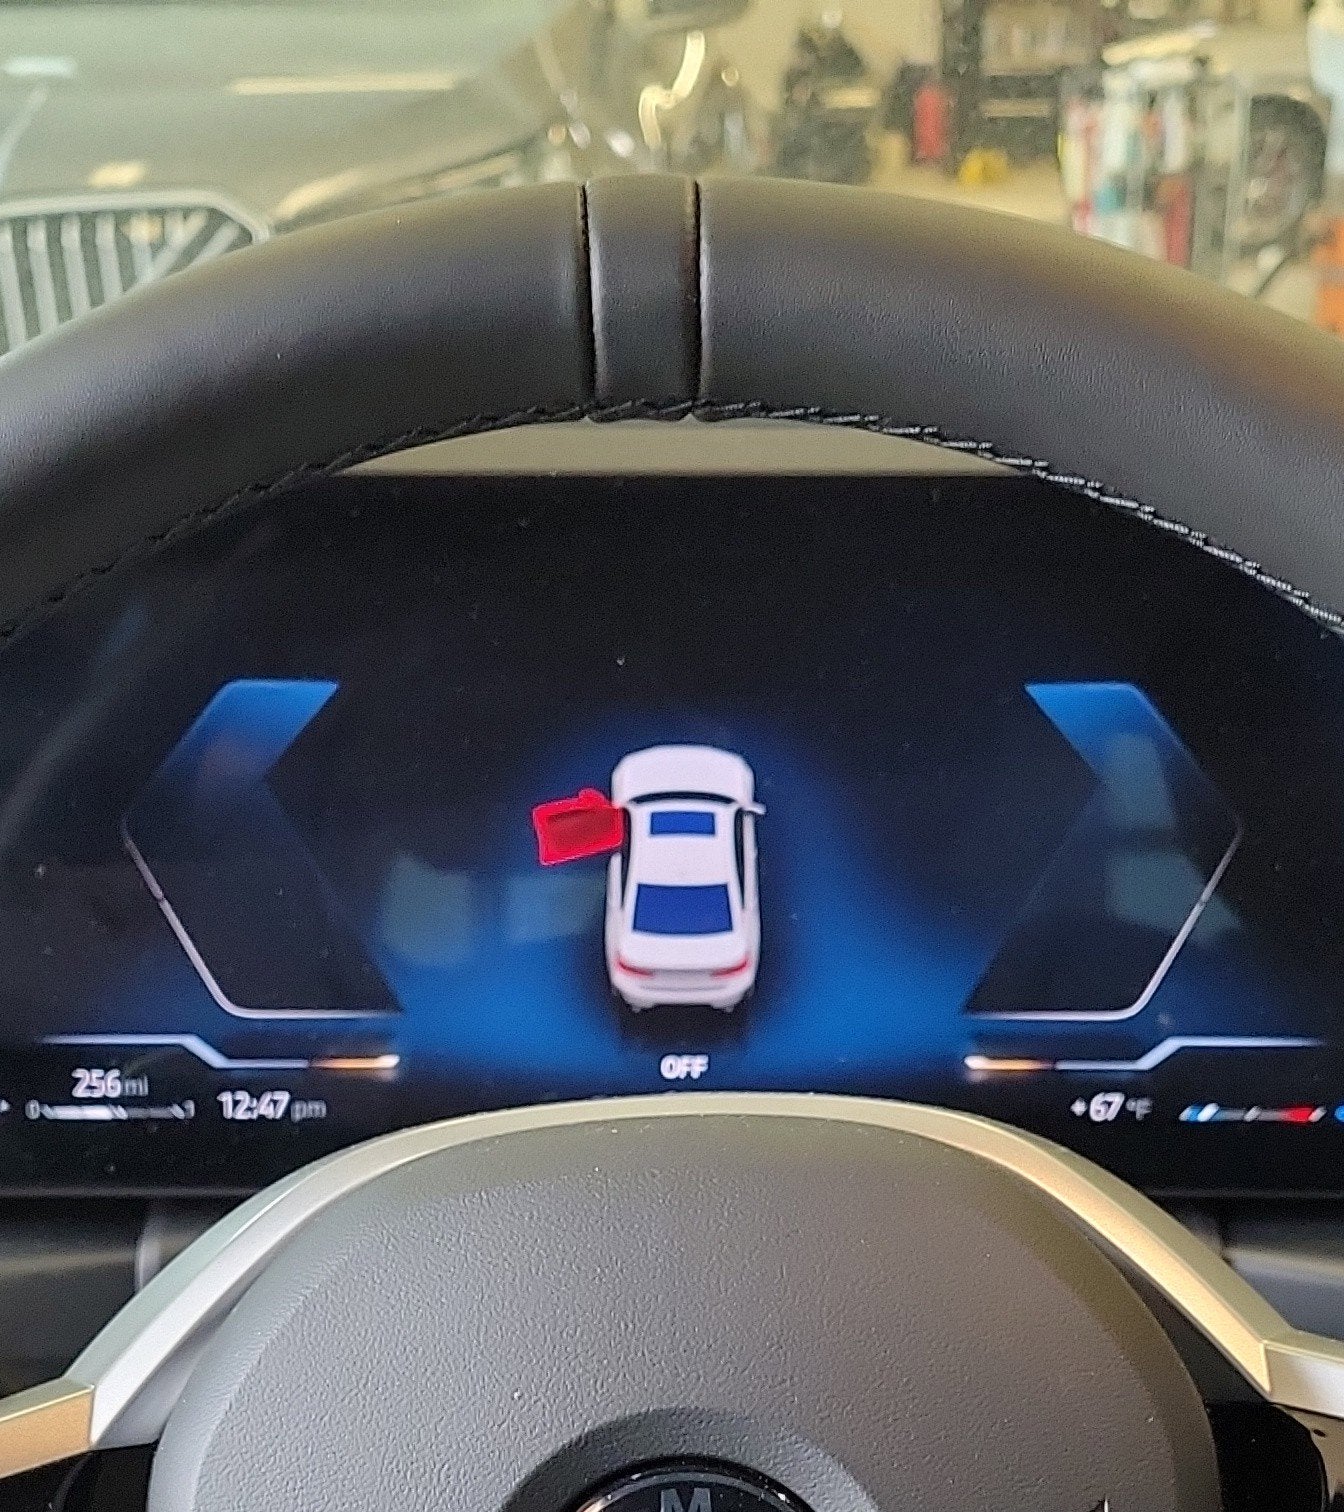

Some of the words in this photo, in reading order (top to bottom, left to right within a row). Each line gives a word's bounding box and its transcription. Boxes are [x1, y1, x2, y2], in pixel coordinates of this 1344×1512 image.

[660, 1055, 709, 1079] OFF
[71, 1068, 121, 1098] 256
[217, 1090, 290, 1120] 12:47
